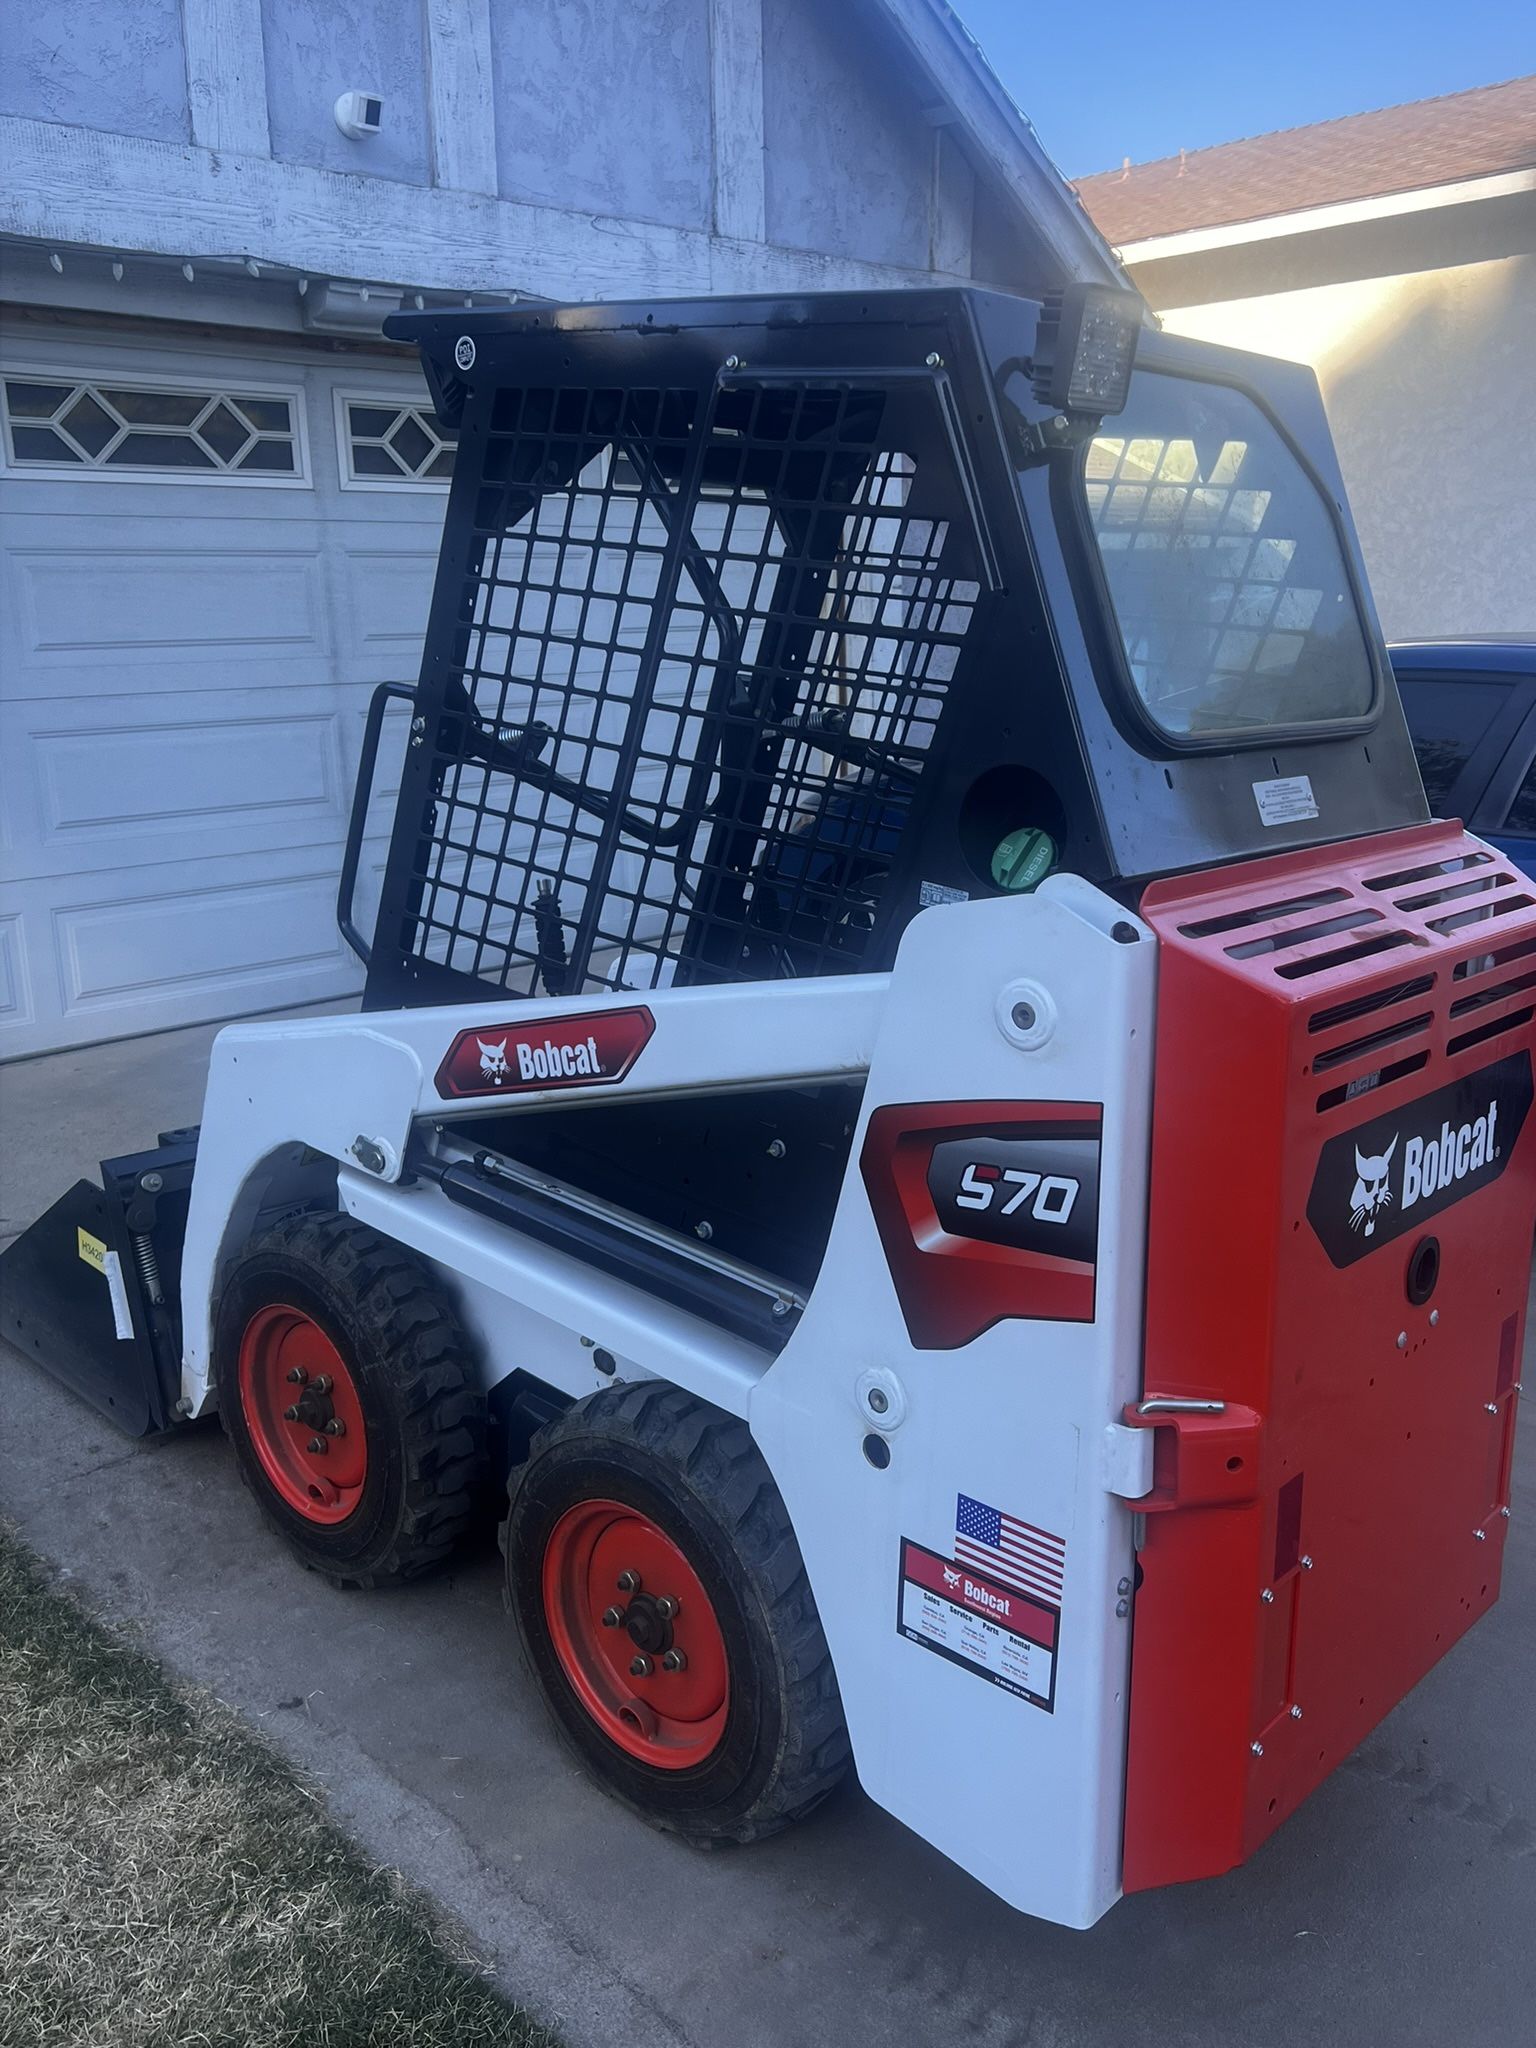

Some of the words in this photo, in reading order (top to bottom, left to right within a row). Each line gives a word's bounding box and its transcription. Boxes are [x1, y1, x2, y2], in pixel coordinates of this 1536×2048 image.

[1020, 846, 1049, 882] DIESEL
[516, 1036, 601, 1080] Bobcat
[1401, 1100, 1497, 1210] Bobcat
[956, 1164, 1080, 1224] S70
[923, 1592, 940, 1606] Sales
[949, 1605, 973, 1622] Service
[982, 1622, 1000, 1636] Parts
[1009, 1635, 1031, 1652] Rental
[964, 1579, 1010, 1616] Bobcat
